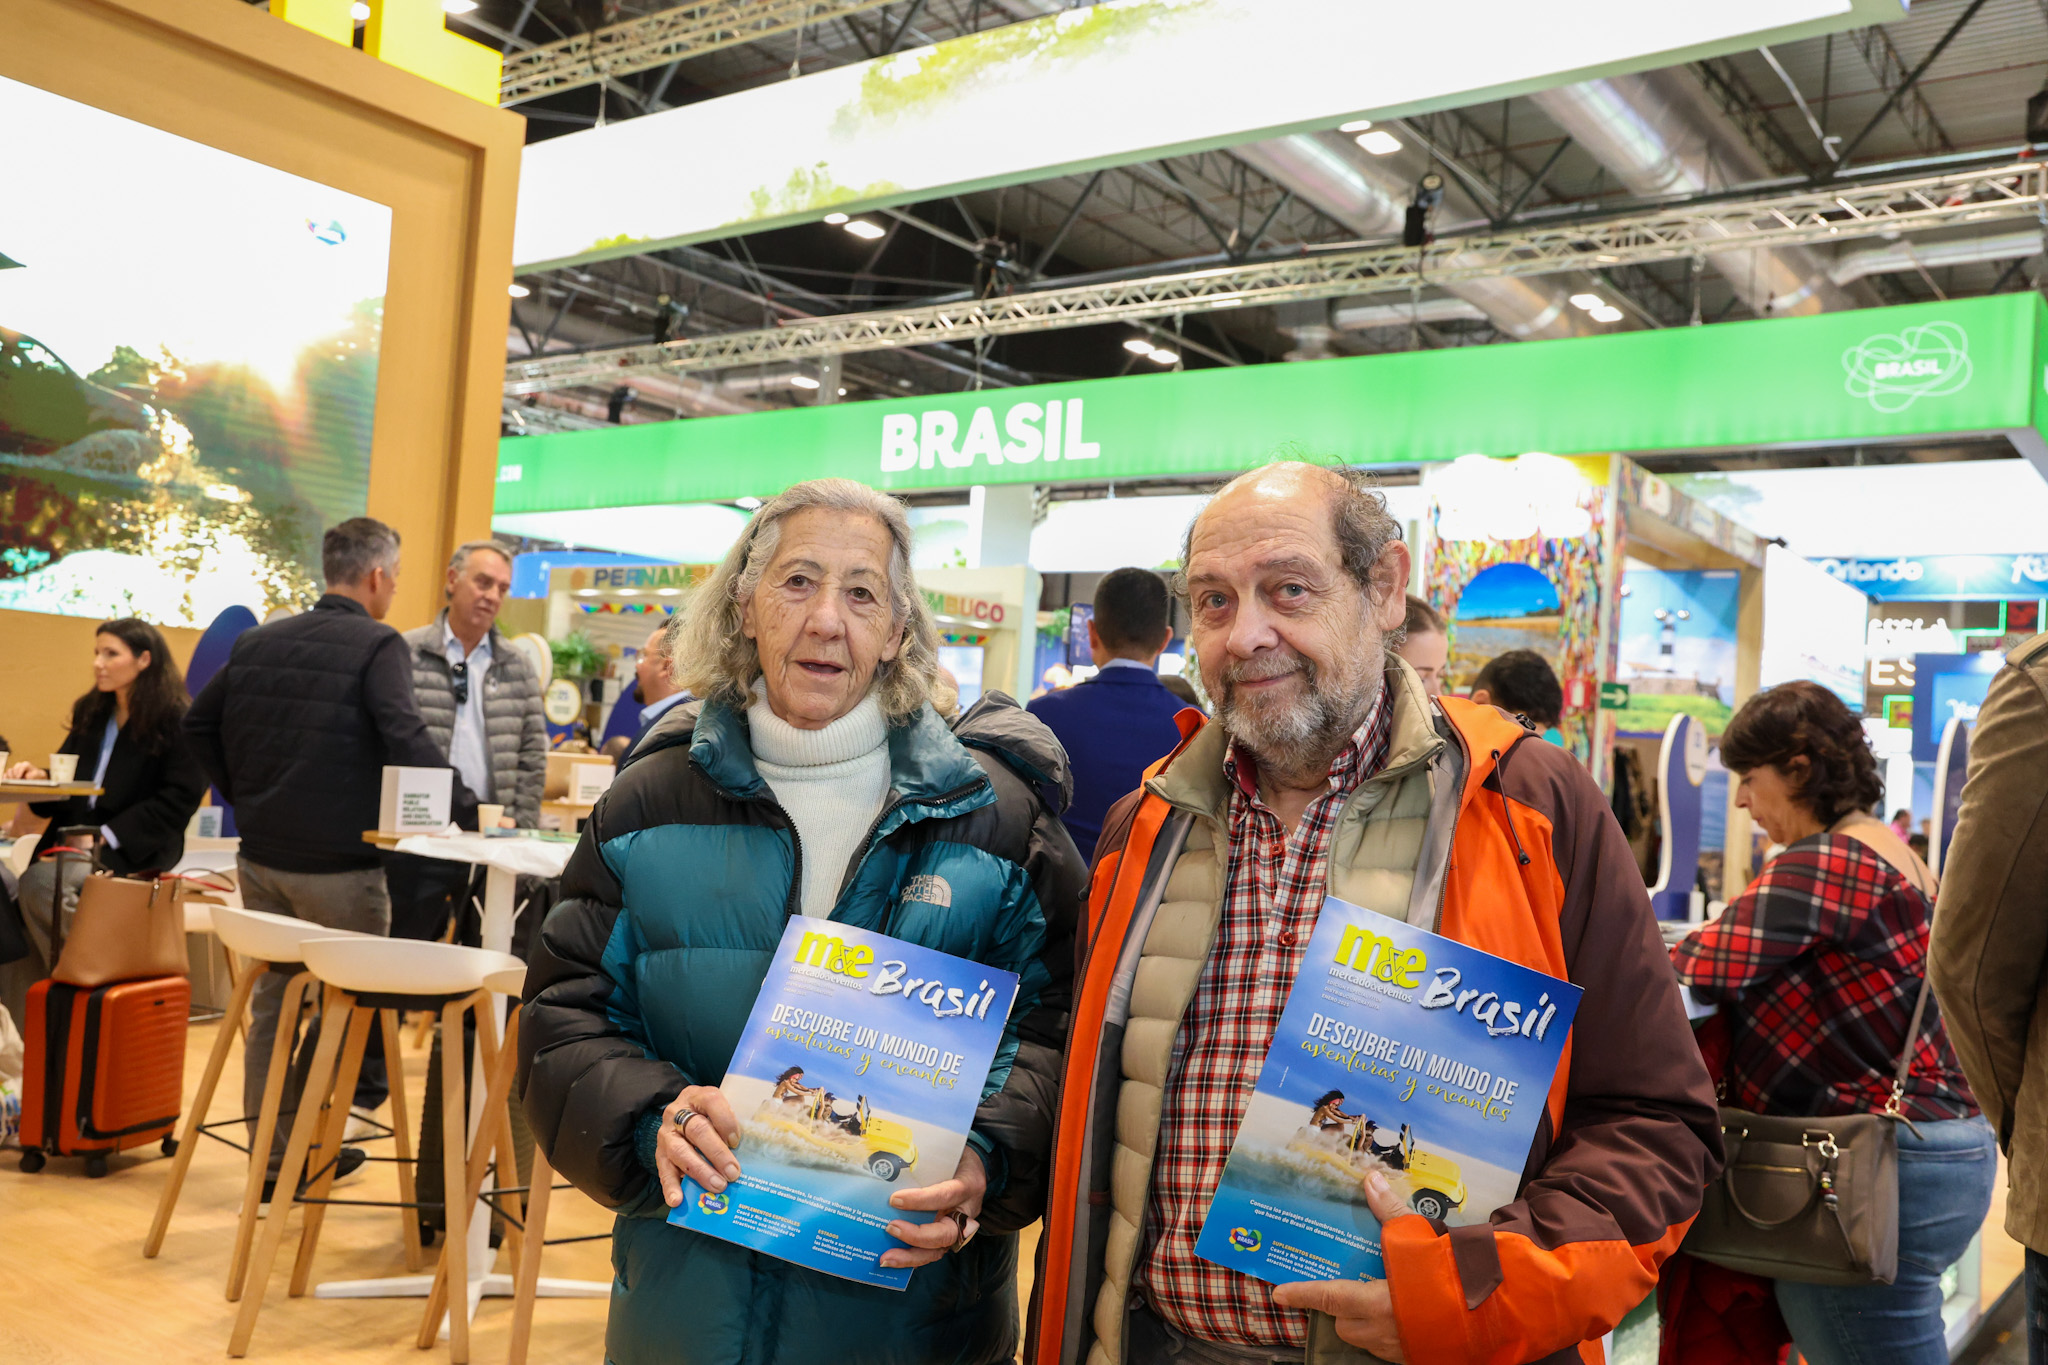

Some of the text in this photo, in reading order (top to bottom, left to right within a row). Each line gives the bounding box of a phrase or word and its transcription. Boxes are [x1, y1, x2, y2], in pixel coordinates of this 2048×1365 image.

[1875, 358, 1943, 379] BRASIL
[881, 398, 1100, 472] BRASIL
[911, 874, 933, 885] THE
[902, 892, 931, 904] FACE
[794, 931, 873, 976] m&e
[1333, 923, 1425, 987] m&e
[867, 960, 995, 1020] Brasil
[1320, 993, 1337, 1003] ENERO
[1328, 966, 1413, 1004] mercado&eventos
[1418, 968, 1556, 1041] Brasil
[770, 1002, 964, 1074] DESCUBRE UN MUNDO DE
[764, 1025, 957, 1088] aventuras y encantos
[1306, 1011, 1519, 1105] DESCUBRE UN MUNDO DE
[1300, 1040, 1399, 1082] aventuras
[1398, 1074, 1419, 1104] y
[1425, 1083, 1510, 1121] encantos
[704, 1199, 722, 1209] BRASIL
[747, 1175, 768, 1186] paisajes
[768, 1182, 807, 1197] deslumbrantes,
[812, 1195, 831, 1204] cultura
[830, 1201, 853, 1212] vibrante
[754, 1184, 770, 1192] Brasil
[776, 1190, 796, 1200] destino
[795, 1196, 825, 1209] inolvidable
[823, 1206, 836, 1214] para
[836, 1209, 856, 1220] turistas
[862, 1218, 875, 1226] todo
[732, 1219, 756, 1230] atractivos
[736, 1208, 750, 1216] Ceará
[762, 1216, 780, 1226] Grande
[787, 1225, 801, 1233] Norte
[737, 1203, 800, 1226] SUPLEMENTOS ESPECIALES
[1249, 1198, 1272, 1211] Conozca
[1272, 1206, 1281, 1214] los
[1281, 1208, 1304, 1222] paisajes
[1304, 1216, 1346, 1236] deslumbrantes,
[1352, 1234, 1372, 1245] cultura
[767, 1224, 788, 1235] infinidad
[817, 1229, 839, 1239] ESTADOS
[1236, 1234, 1255, 1246] BRASIL
[1253, 1208, 1265, 1216] que
[1265, 1211, 1281, 1221] hacen
[1289, 1218, 1306, 1229] Brasil
[1313, 1227, 1334, 1239] destino
[1334, 1235, 1366, 1251] inolvidable
[1365, 1247, 1378, 1256] para
[811, 1245, 831, 1254] destinos
[820, 1242, 838, 1251] bellezas
[851, 1251, 874, 1263] principales
[1265, 1257, 1291, 1270] atractivos
[1269, 1245, 1285, 1255] Ceará
[1298, 1256, 1317, 1267] Grande
[1325, 1266, 1340, 1275] Norte
[1272, 1240, 1308, 1257] SUPLEMENTOS
[1308, 1253, 1339, 1268] ESPECIALES
[1304, 1264, 1327, 1277] infinidad
